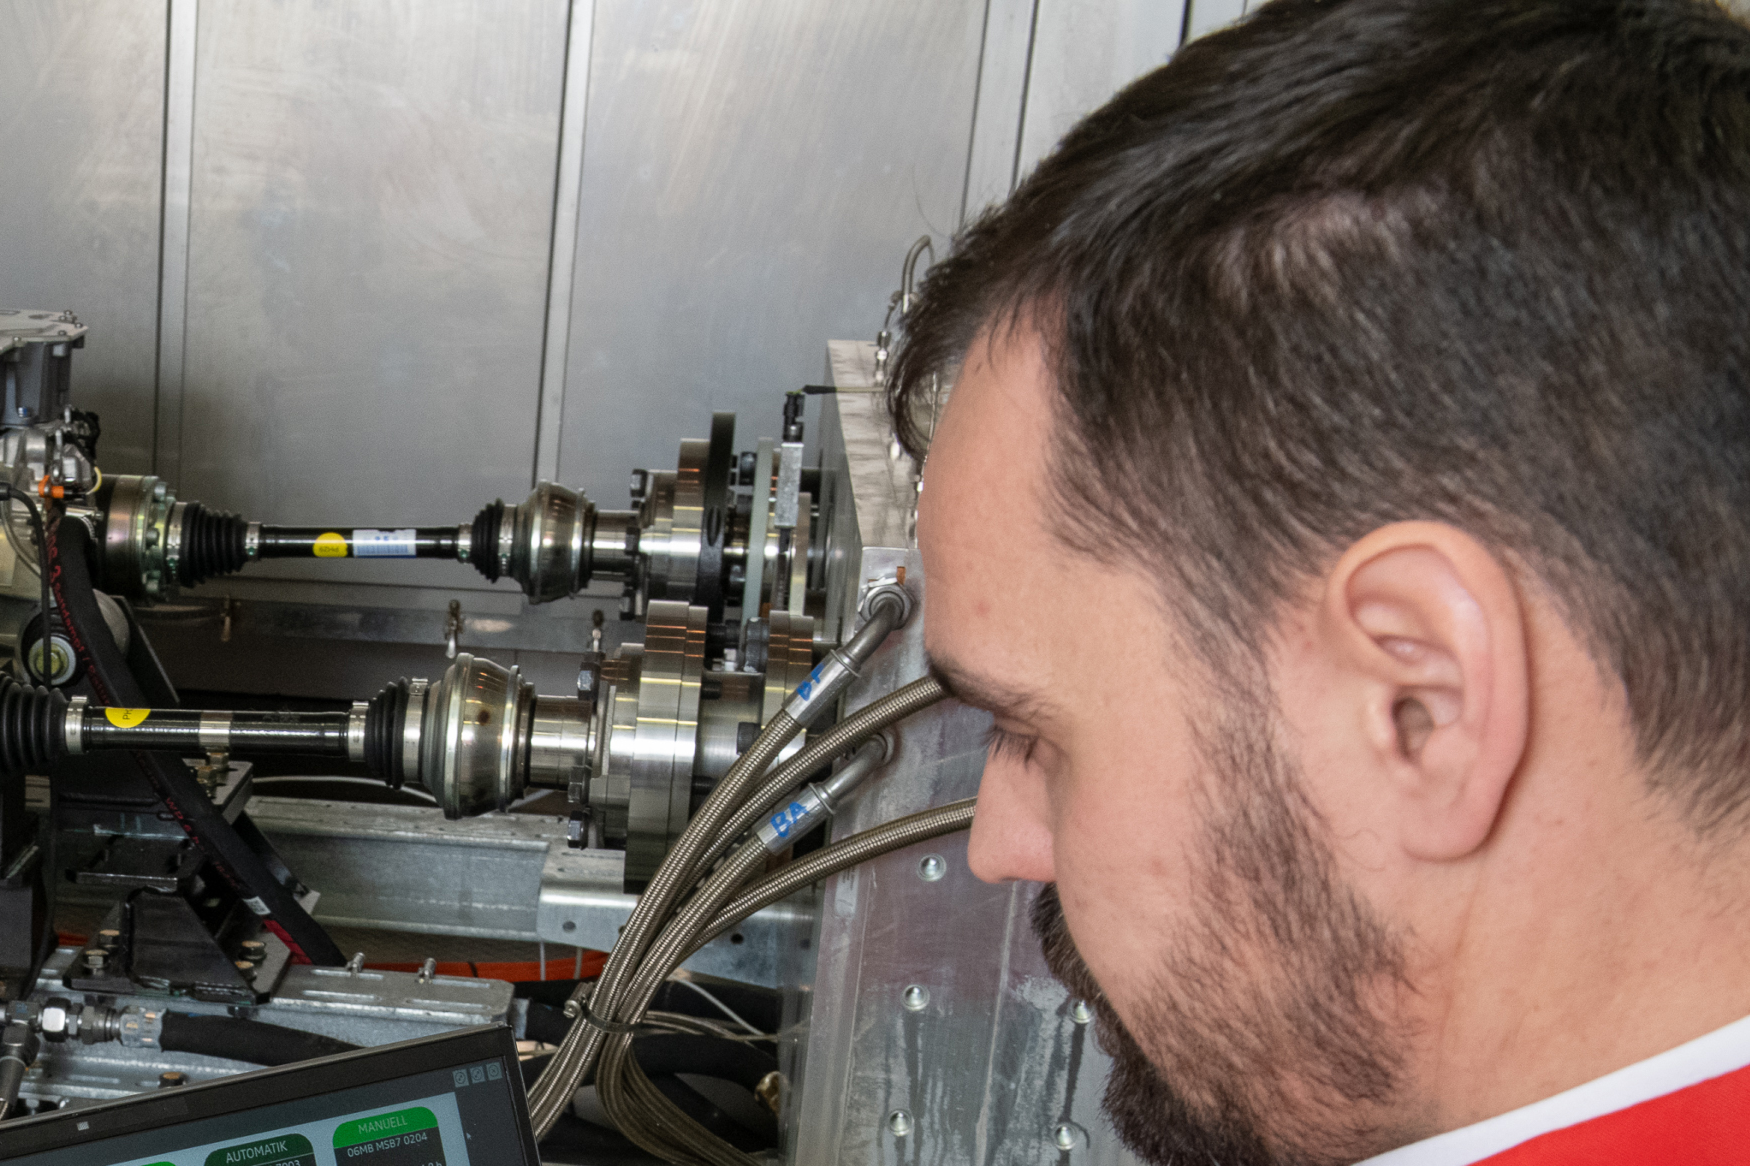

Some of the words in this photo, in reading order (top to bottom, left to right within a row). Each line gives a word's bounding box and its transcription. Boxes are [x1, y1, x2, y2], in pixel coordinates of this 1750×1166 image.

[770, 801, 810, 838] BA
[357, 1115, 408, 1134] MANUELL
[226, 1140, 288, 1163] AUTOMATIK
